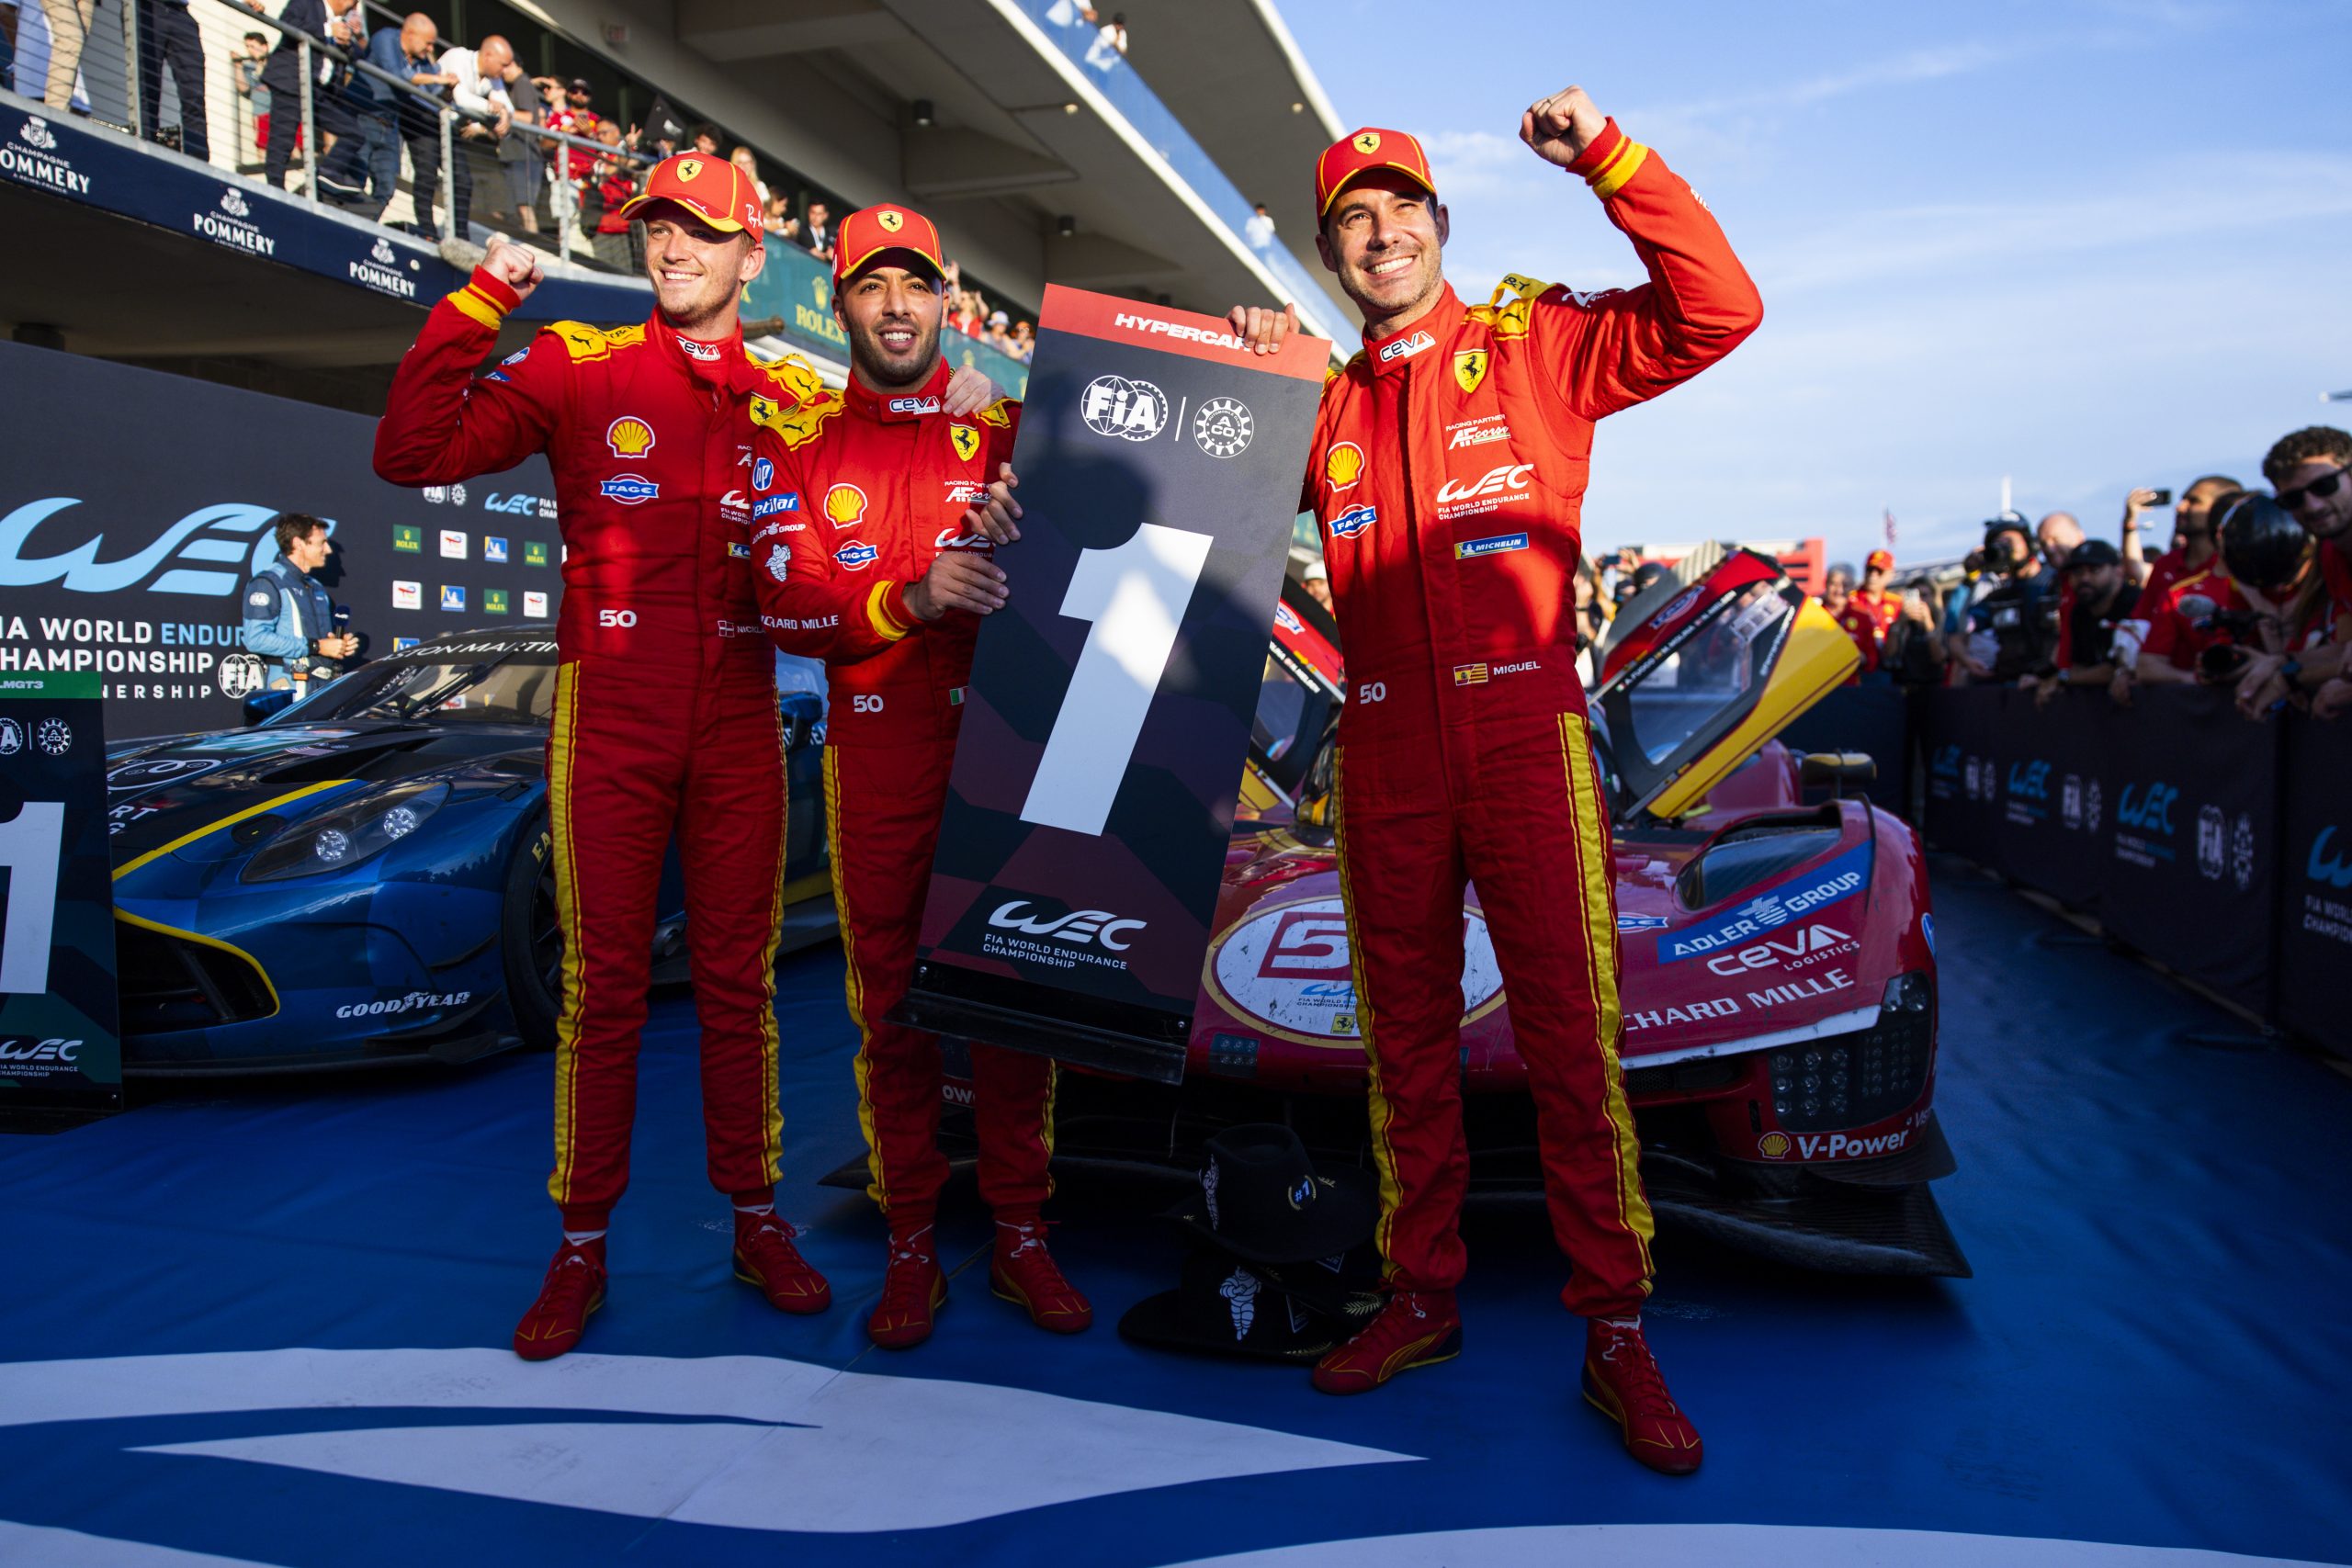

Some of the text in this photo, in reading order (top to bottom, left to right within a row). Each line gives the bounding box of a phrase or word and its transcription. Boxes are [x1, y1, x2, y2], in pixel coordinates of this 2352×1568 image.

[6, 141, 71, 169] CHAMPAGNE
[0, 148, 90, 195] OMMERY
[209, 210, 260, 233] CHAMPAGNE
[193, 212, 276, 255] POMMERY
[349, 261, 416, 298] POMMERY
[796, 303, 846, 346] ROLEX
[914, 406, 941, 414] LOGISTIC
[1445, 414, 1506, 432] RACING PARTNER
[970, 480, 991, 489] PARTN
[1436, 463, 1534, 503] WEC
[484, 492, 537, 515] WEC
[731, 510, 750, 519] WORL
[1438, 492, 1530, 514] FIA WORLD ENDURANCE
[1438, 503, 1498, 520] CHAMPIONSHIP
[779, 524, 806, 534] GROUP
[934, 527, 992, 547] WE
[396, 540, 418, 550] ROLEX
[1476, 537, 1521, 551] MICHELIN
[486, 603, 506, 612] ROLEX
[599, 609, 637, 627] 50
[0, 616, 29, 640] IA
[39, 617, 153, 643] WORLD
[738, 626, 765, 634] NICKLA
[801, 615, 839, 630] MILLE
[0, 648, 214, 673] HAMPIONSHIP
[1493, 660, 1542, 675] MIGUEL
[1019, 522, 1214, 837] 1
[854, 694, 884, 713] 50
[1360, 682, 1386, 705] 50
[2117, 781, 2178, 835] WEC
[988, 900, 1148, 951] WEC
[1675, 871, 1861, 957] ADLER GROUP
[983, 943, 1075, 968] CHAMPIONSHIP
[984, 933, 1127, 970] FIA WORLD ENDURANCE
[1271, 919, 1352, 970] 5
[1783, 941, 1860, 971] LOGISTICS
[1746, 967, 1856, 1009] MILLE
[0, 1038, 84, 1061] WEC
[36, 1065, 78, 1073] ENDURANCE
[1797, 1129, 1910, 1160] V-Power
